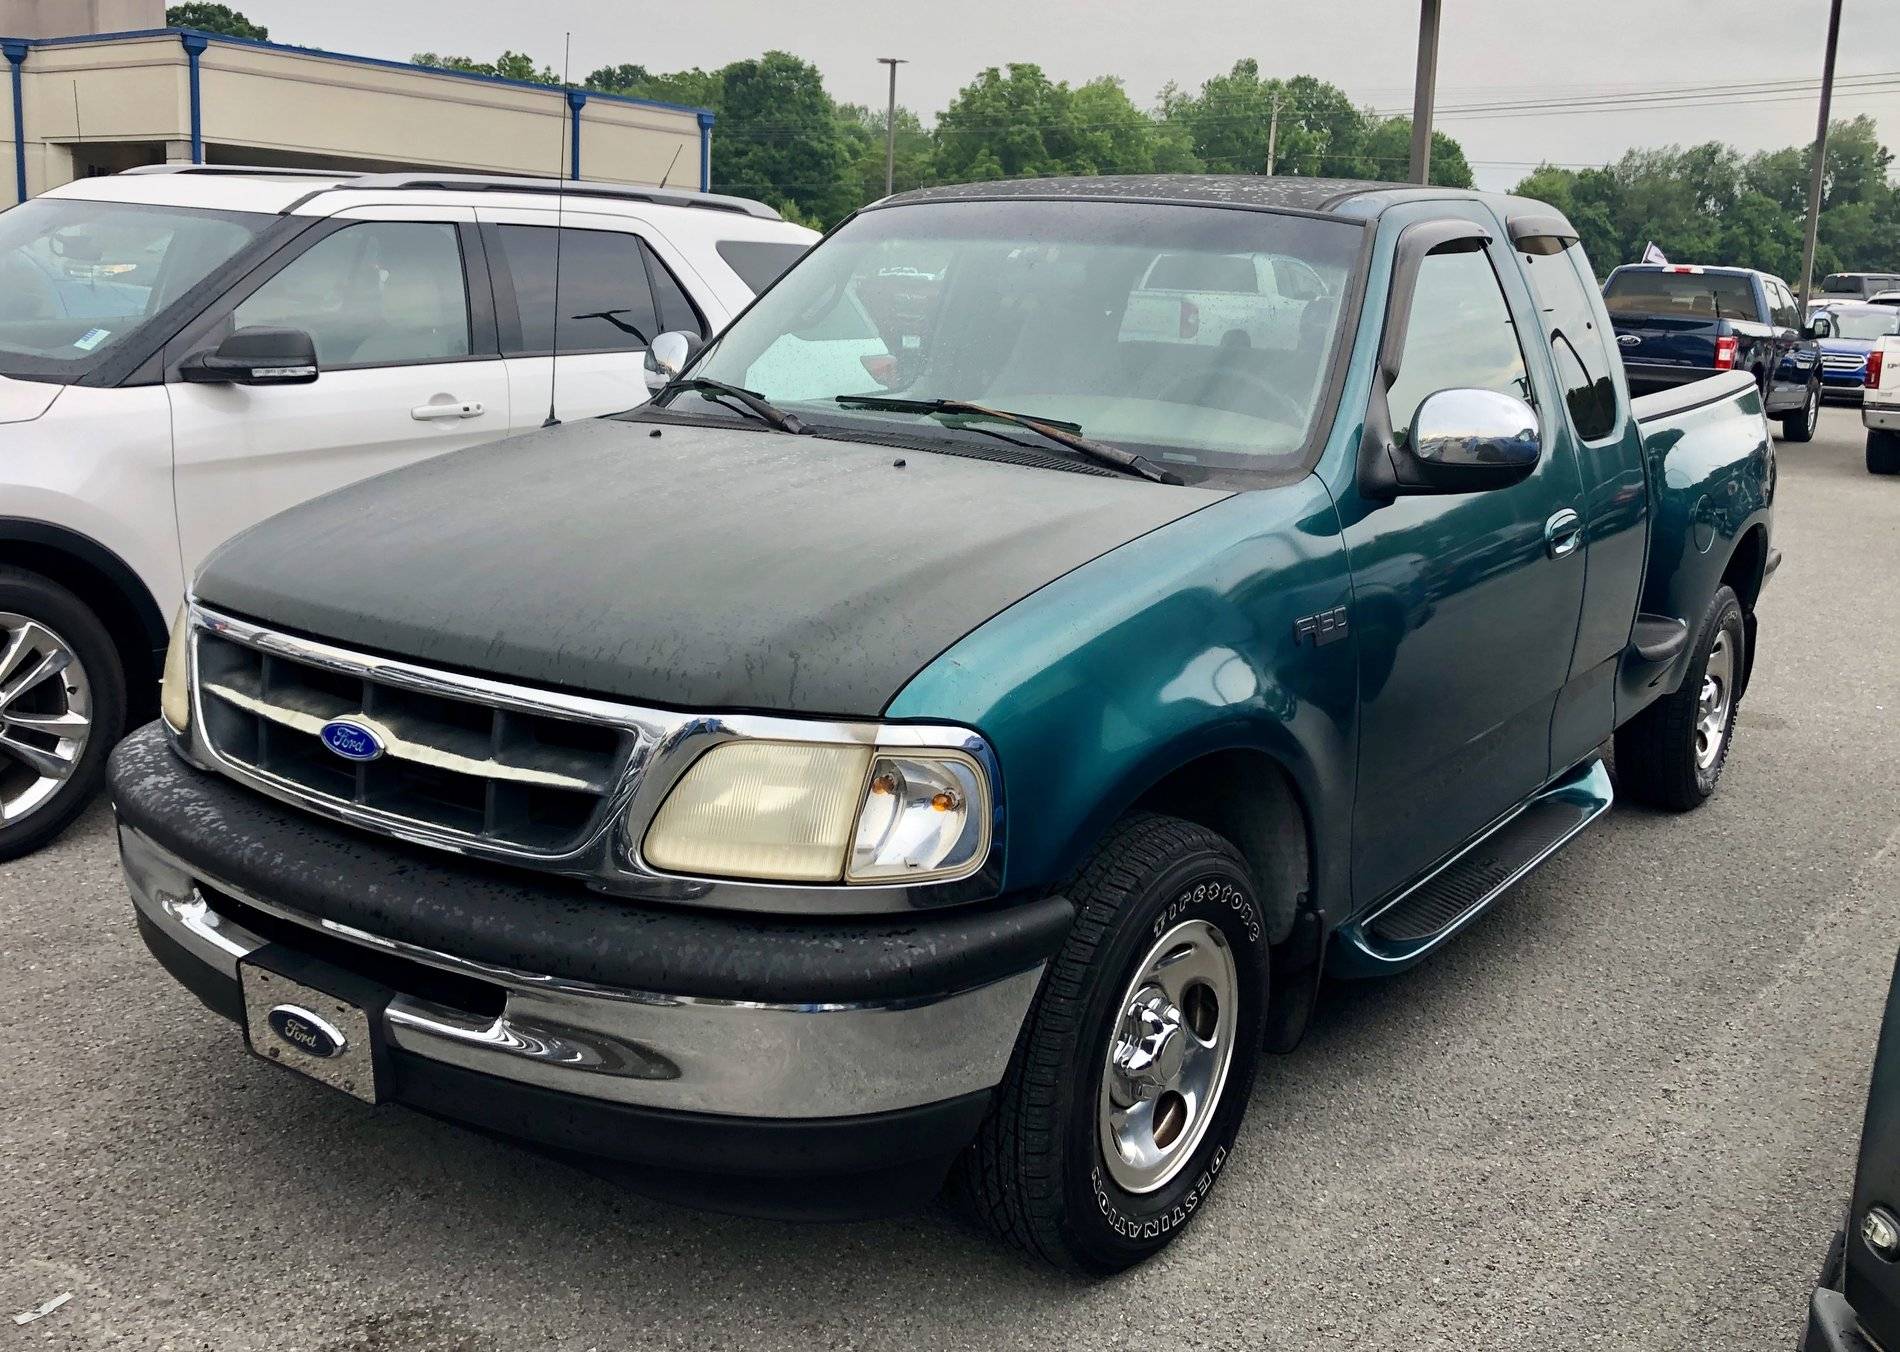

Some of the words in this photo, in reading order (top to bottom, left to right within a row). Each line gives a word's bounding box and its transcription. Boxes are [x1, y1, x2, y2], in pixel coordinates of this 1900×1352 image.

[333, 726, 366, 753] Ford
[284, 1018, 317, 1048] Ford
[1091, 1145, 1227, 1238] DESTINATION
